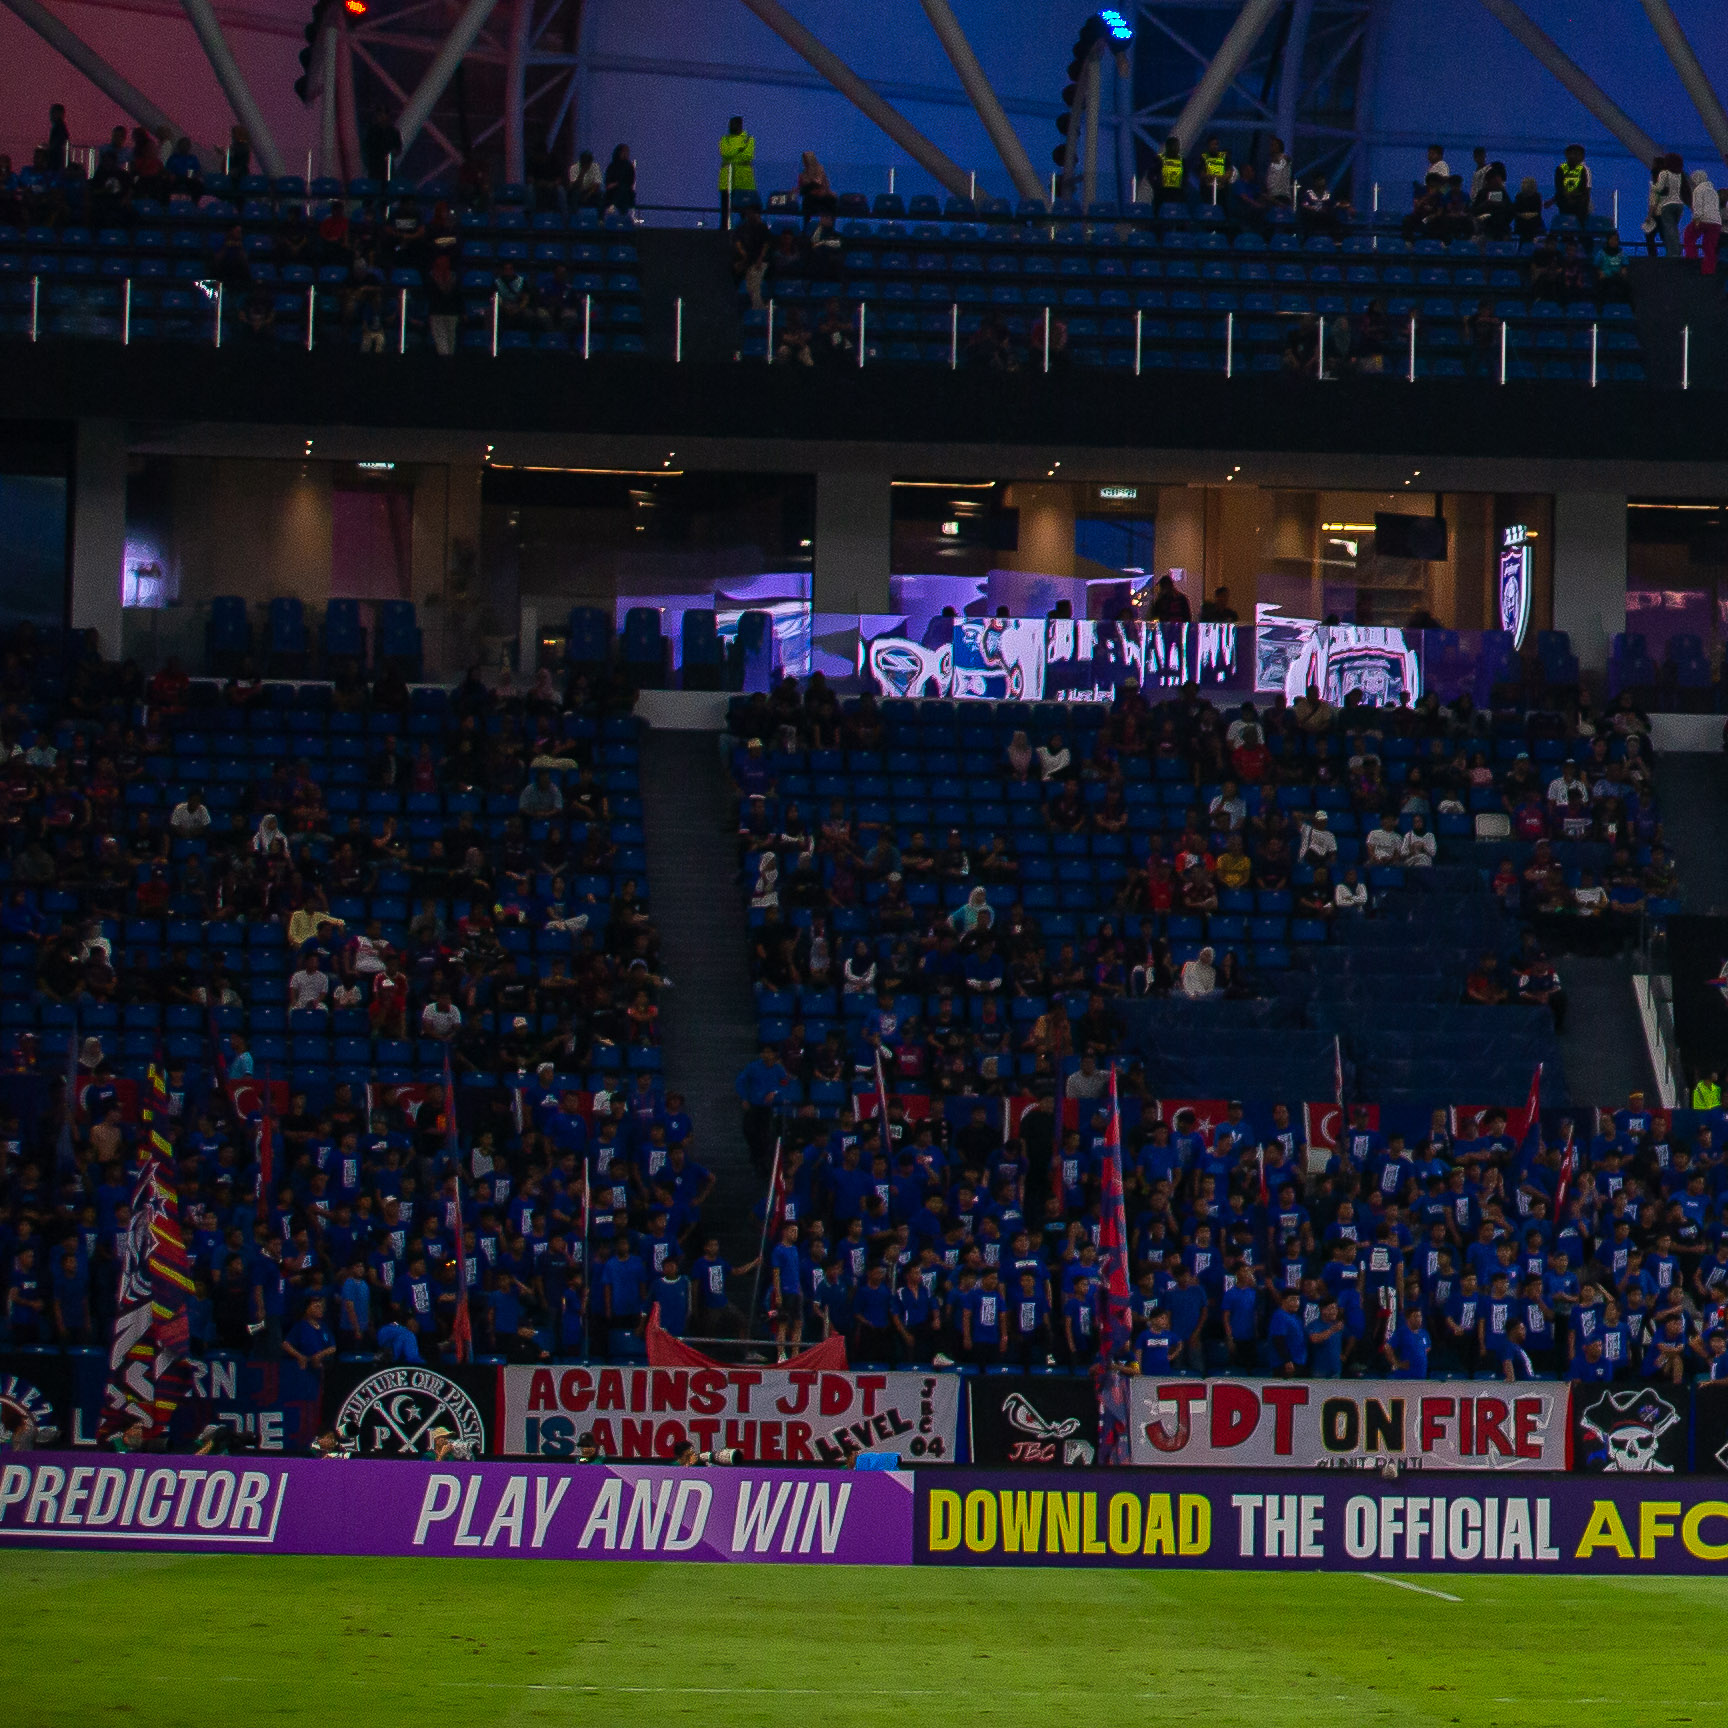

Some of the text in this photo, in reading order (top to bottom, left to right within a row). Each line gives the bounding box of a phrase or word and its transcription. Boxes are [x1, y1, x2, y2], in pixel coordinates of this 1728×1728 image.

[527, 1368, 887, 1417] AGAINST JDT
[1145, 1382, 1546, 1459] JDT ON FIRE
[525, 1415, 814, 1463] IS ANOTHER
[814, 1407, 914, 1462] LEVEL
[0, 1465, 271, 1529] PREDICTOR
[412, 1474, 852, 1555] PLAY AND WIN
[929, 1489, 1213, 1556] DOWNLOAD
[1231, 1494, 1326, 1558] THE
[1344, 1495, 1560, 1561] OFFICIAL
